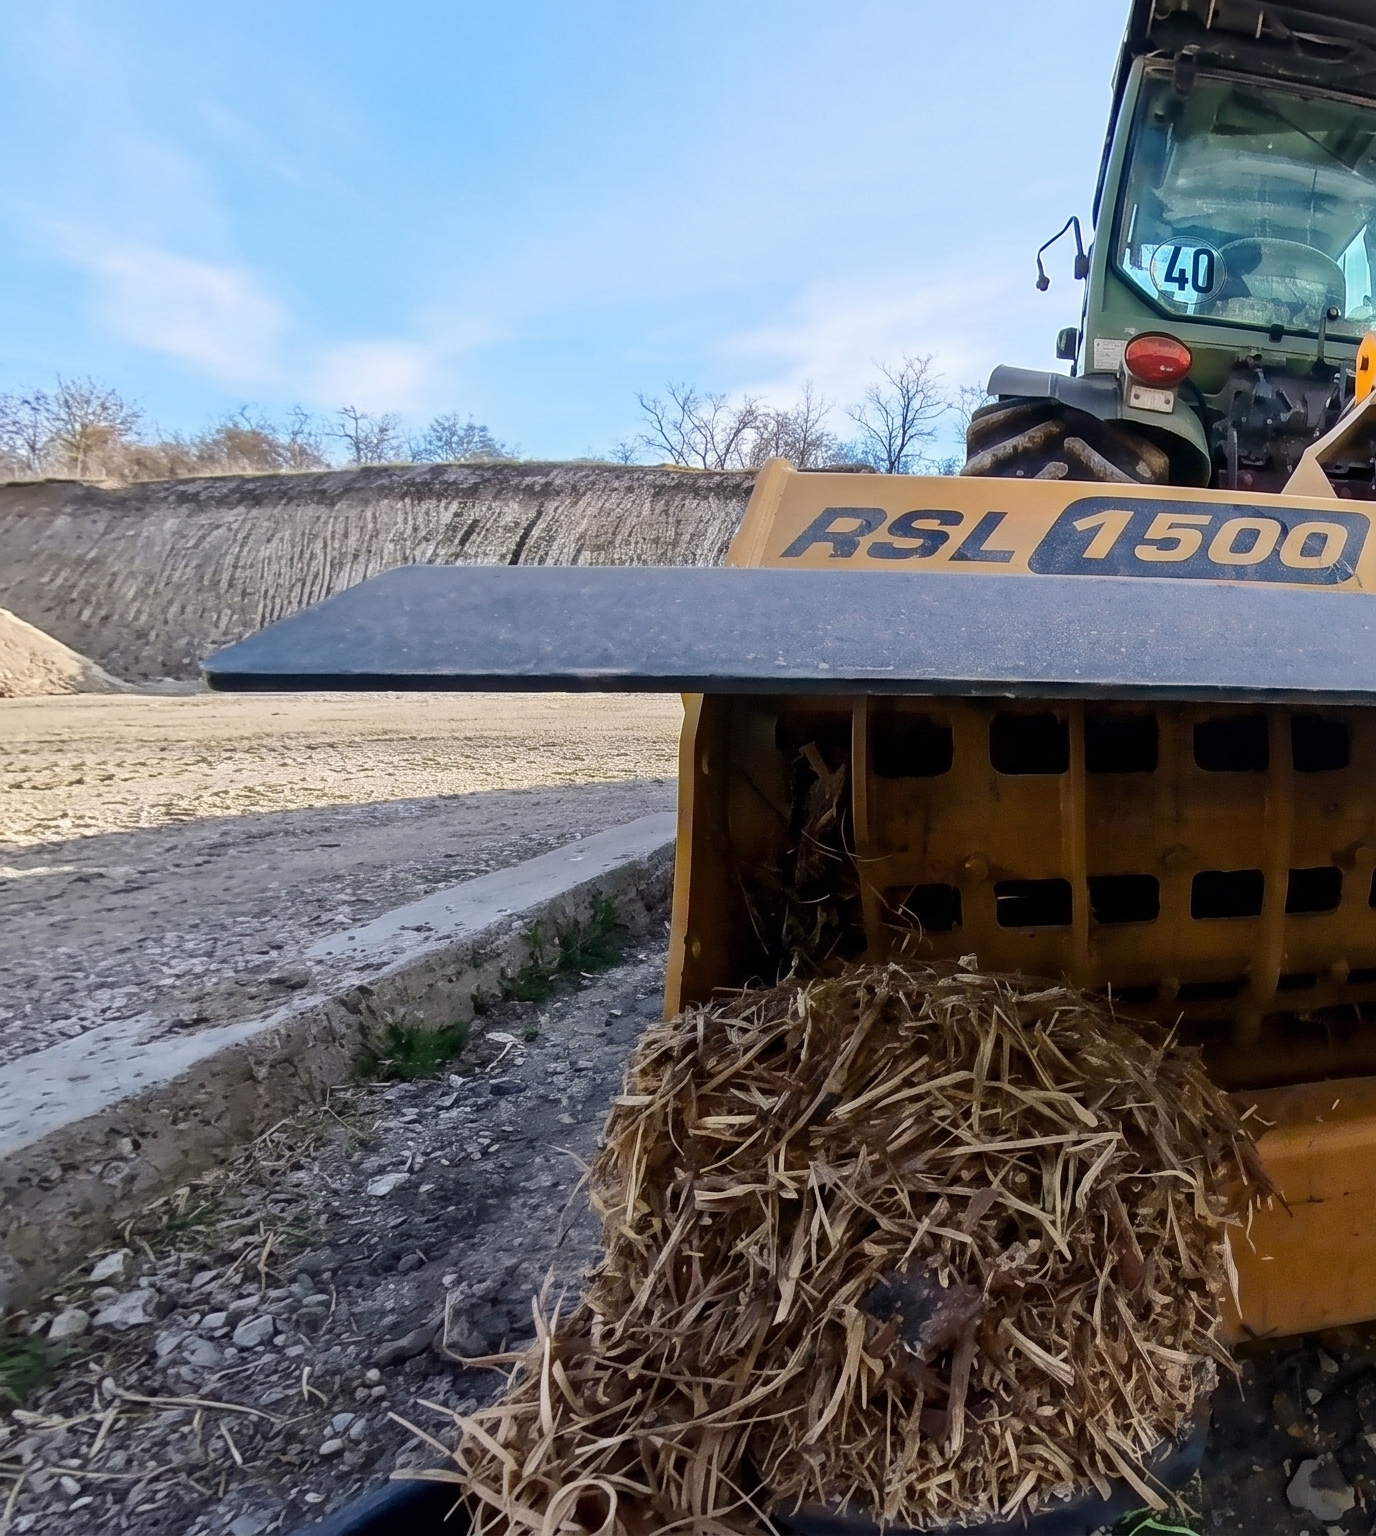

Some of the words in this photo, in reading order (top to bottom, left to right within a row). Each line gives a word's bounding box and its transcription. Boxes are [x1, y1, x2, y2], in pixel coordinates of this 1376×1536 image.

[1164, 246, 1215, 294] 40
[779, 507, 1016, 563] RSL
[1072, 510, 1349, 569] 1500
